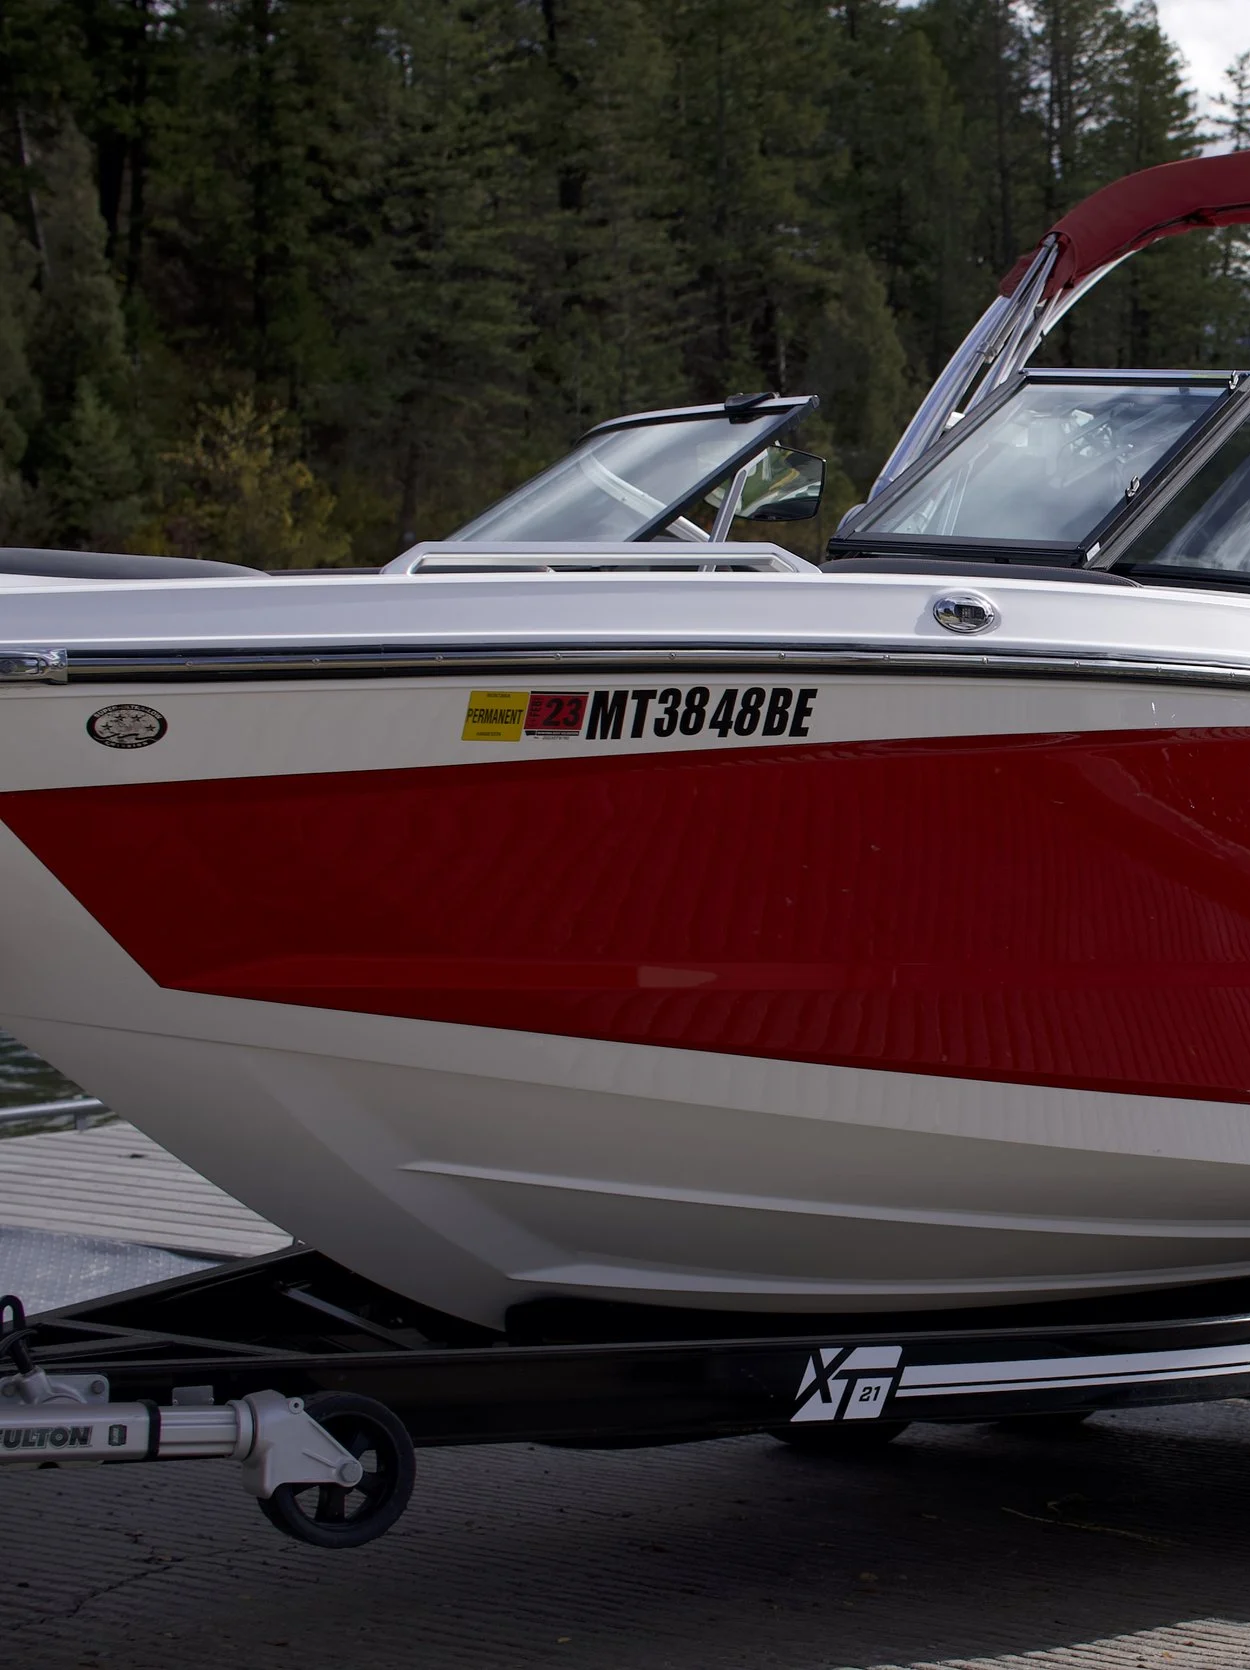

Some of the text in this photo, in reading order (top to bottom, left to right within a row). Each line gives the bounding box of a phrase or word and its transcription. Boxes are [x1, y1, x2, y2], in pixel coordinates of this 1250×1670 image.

[466, 708, 524, 725] PERMANENT
[542, 698, 583, 726] 23
[585, 686, 818, 740] MT3848BE
[790, 1346, 898, 1421] XT 21
